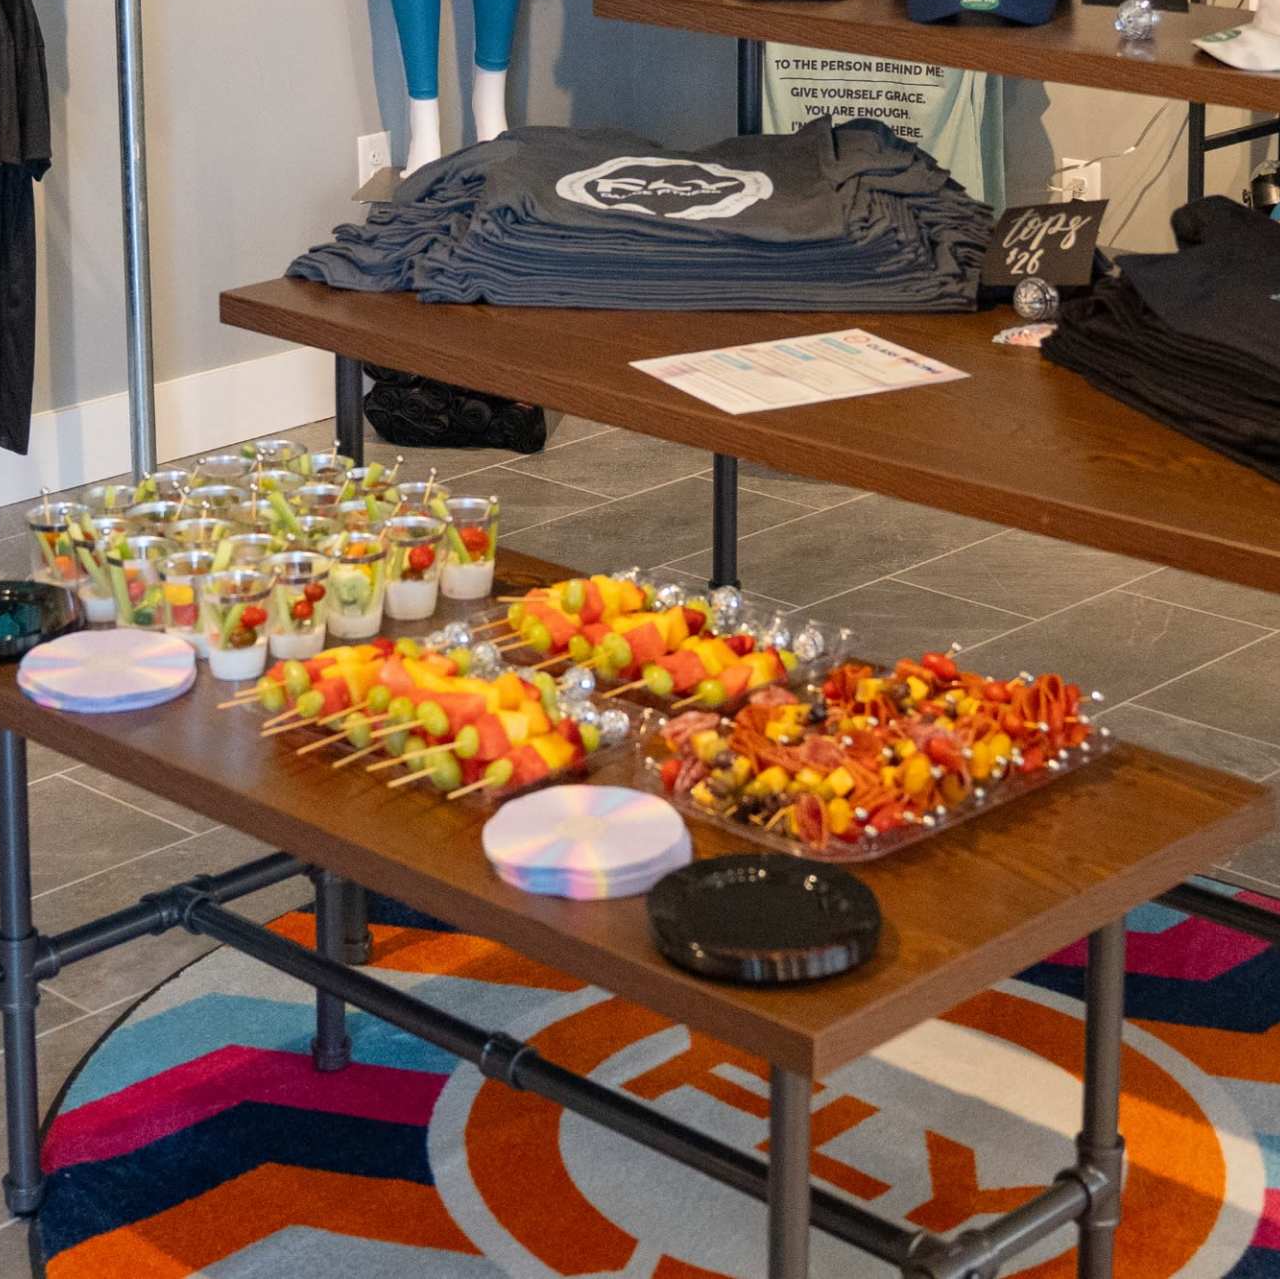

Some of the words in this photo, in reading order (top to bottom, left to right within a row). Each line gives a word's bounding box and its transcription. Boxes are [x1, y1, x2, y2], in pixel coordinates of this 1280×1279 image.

[775, 59, 791, 71] TO
[791, 59, 818, 71] THE
[820, 60, 872, 72] PERSON
[875, 62, 922, 76] BEHIND
[925, 65, 944, 78] ME:
[790, 87, 818, 99] GIVE
[819, 88, 883, 101] YOURSELF
[885, 90, 926, 104] GRACE.
[805, 105, 831, 117] YOU
[831, 105, 856, 117] ARE
[857, 107, 912, 120] ENOUGH.
[1002, 208, 1093, 251] tops
[1006, 247, 1045, 275] $26
